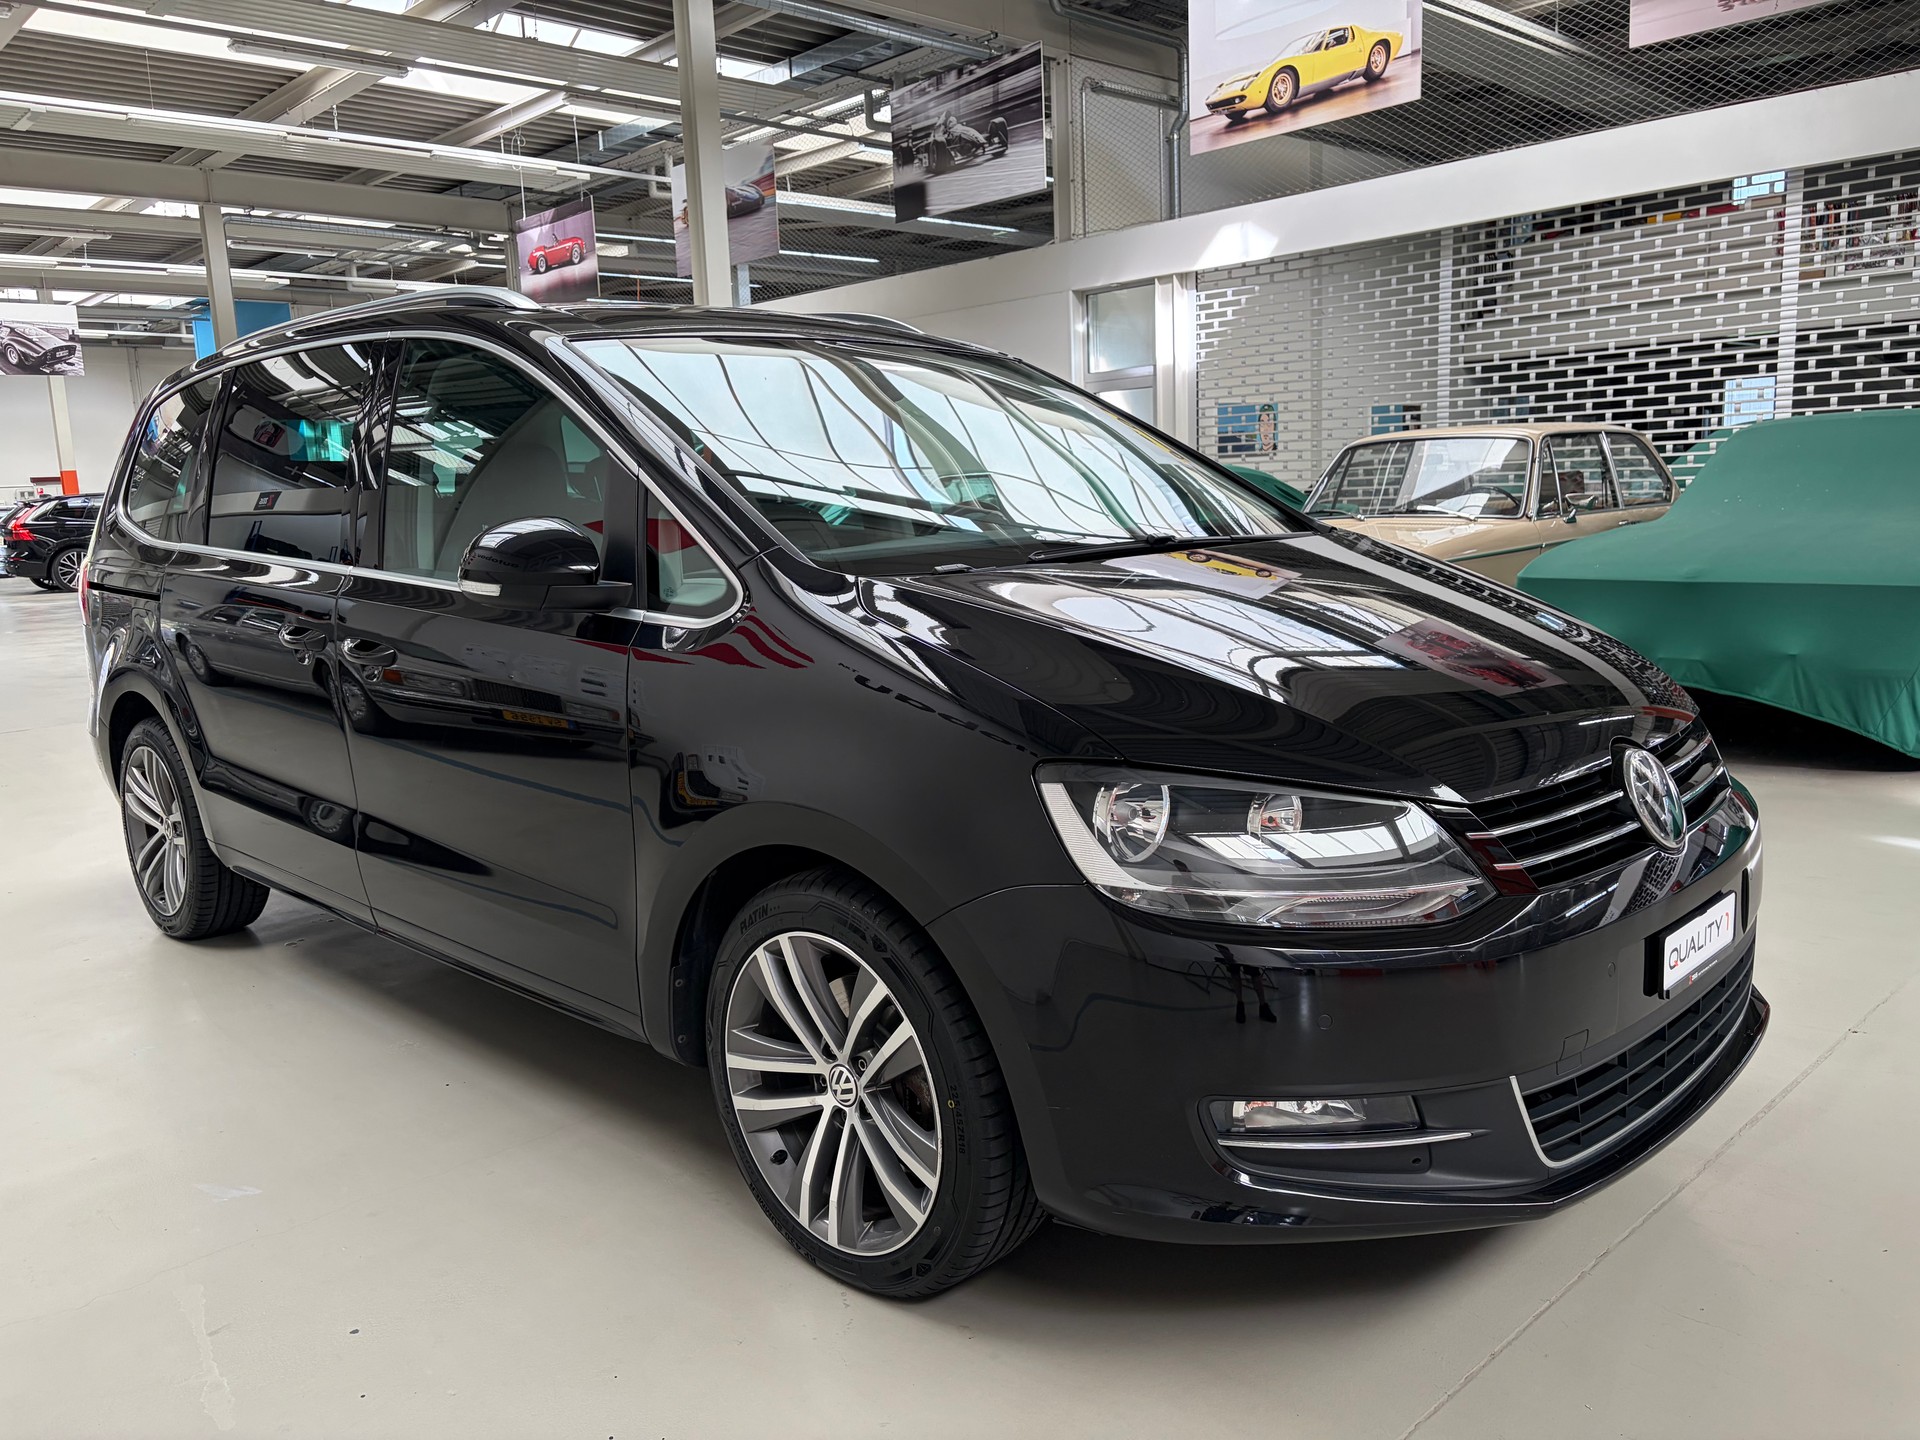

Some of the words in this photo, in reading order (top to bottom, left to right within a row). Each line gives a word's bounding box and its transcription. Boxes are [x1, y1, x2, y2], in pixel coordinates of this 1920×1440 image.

[740, 903, 769, 935] PLATIN
[1668, 914, 1724, 971] QUALITY
[1725, 911, 1730, 931] 1
